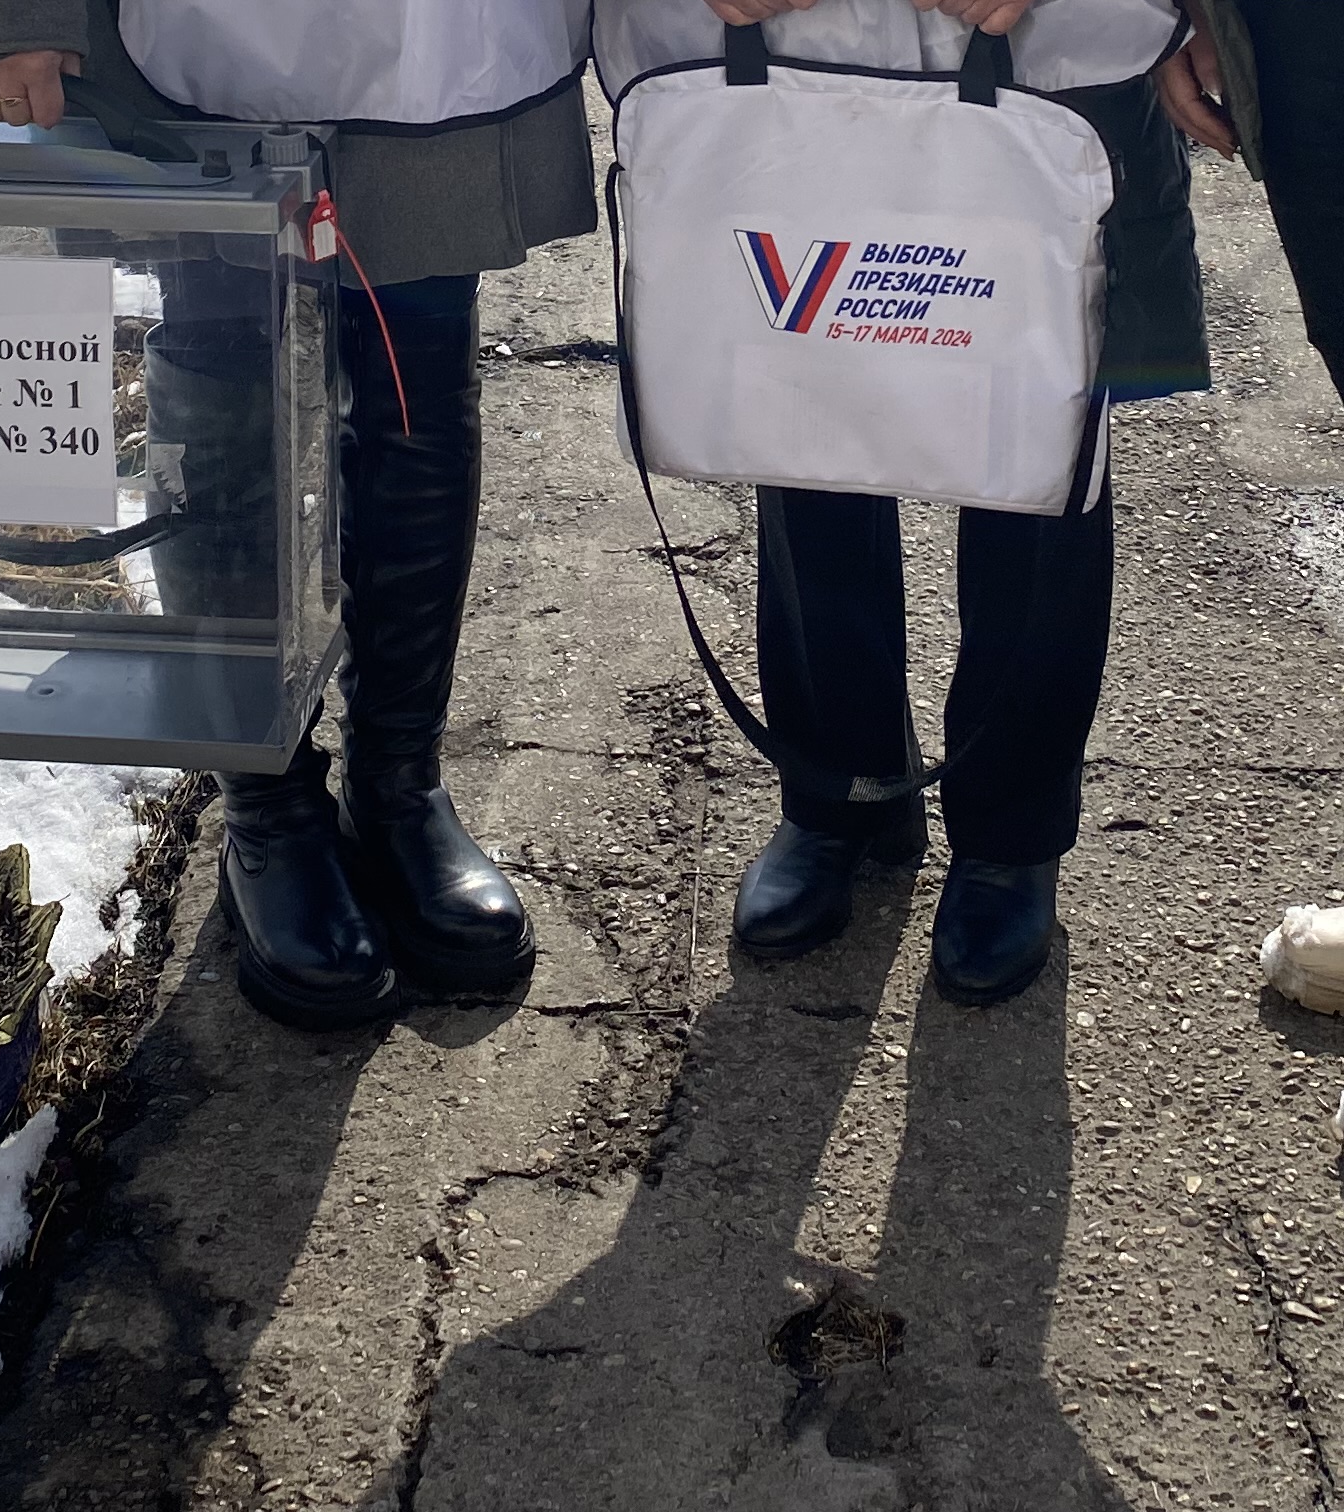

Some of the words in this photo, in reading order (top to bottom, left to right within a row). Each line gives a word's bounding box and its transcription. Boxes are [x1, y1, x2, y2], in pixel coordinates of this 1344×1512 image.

[860, 243, 967, 268] ВЫБОРЫ
[847, 270, 996, 299] ПРЕЗИДЕНТА
[834, 298, 931, 320] РОССИИ
[872, 326, 930, 345] МАРТА
[931, 328, 973, 348] 2024
[13, 378, 53, 408] №
[67, 380, 83, 409] 1
[39, 425, 100, 456] 340
